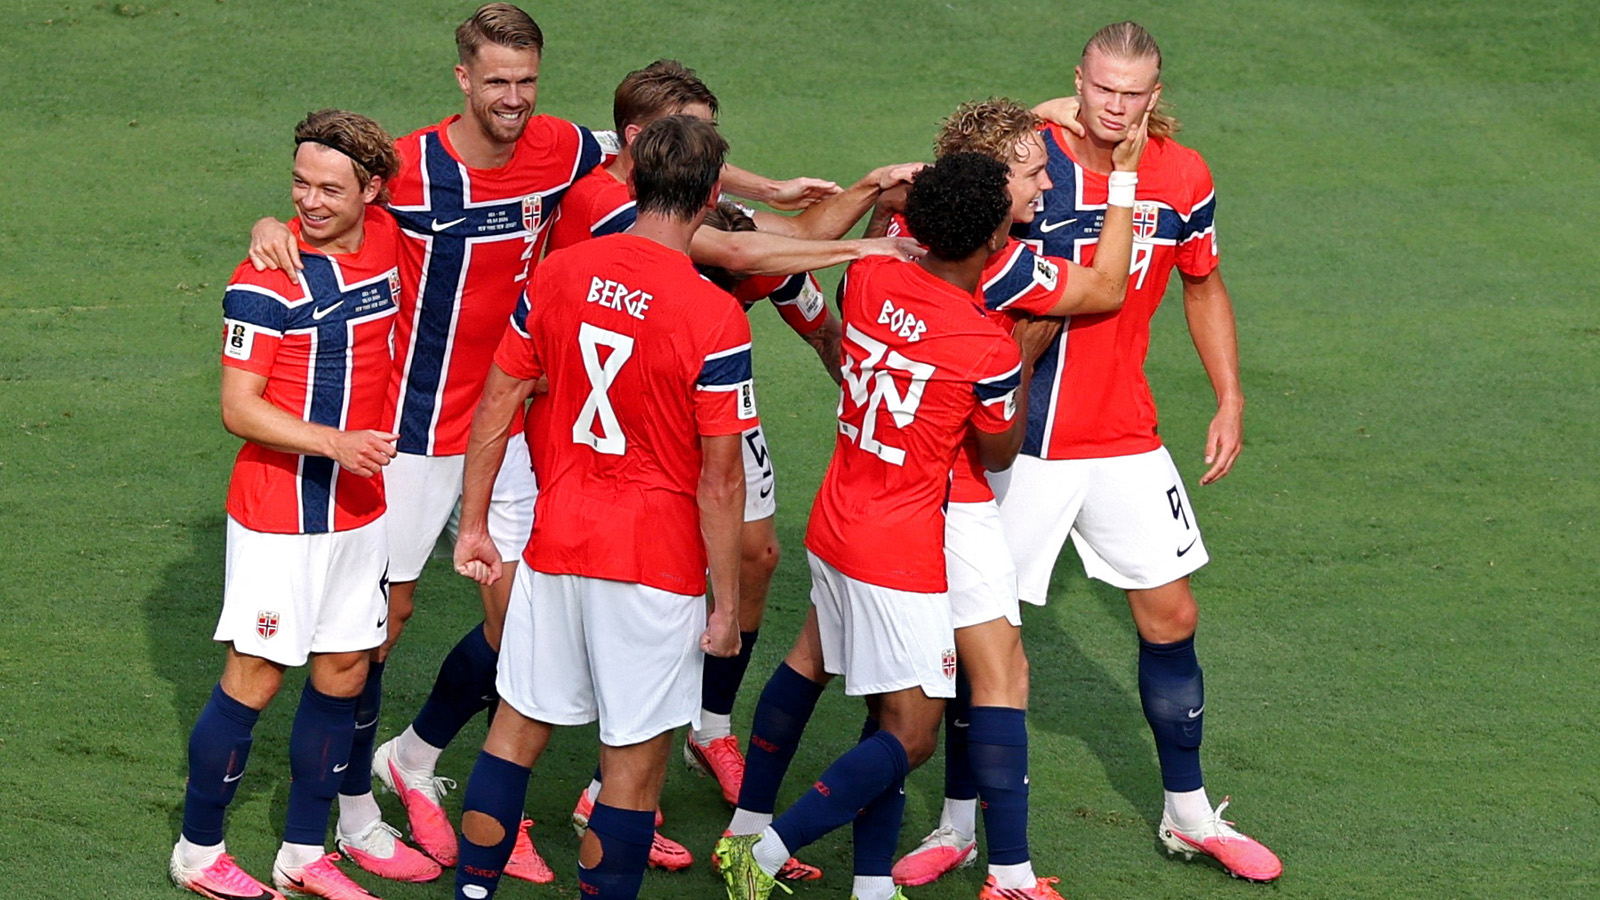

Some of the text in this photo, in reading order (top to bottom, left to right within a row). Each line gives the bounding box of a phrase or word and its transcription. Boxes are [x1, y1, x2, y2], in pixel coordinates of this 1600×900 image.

[1129, 242, 1154, 290] 9
[587, 275, 654, 321] BERGE
[877, 299, 927, 343] BOBB
[572, 321, 635, 456] 8
[837, 321, 936, 467] 22
[745, 430, 772, 479] 5
[1166, 484, 1190, 530] 9
